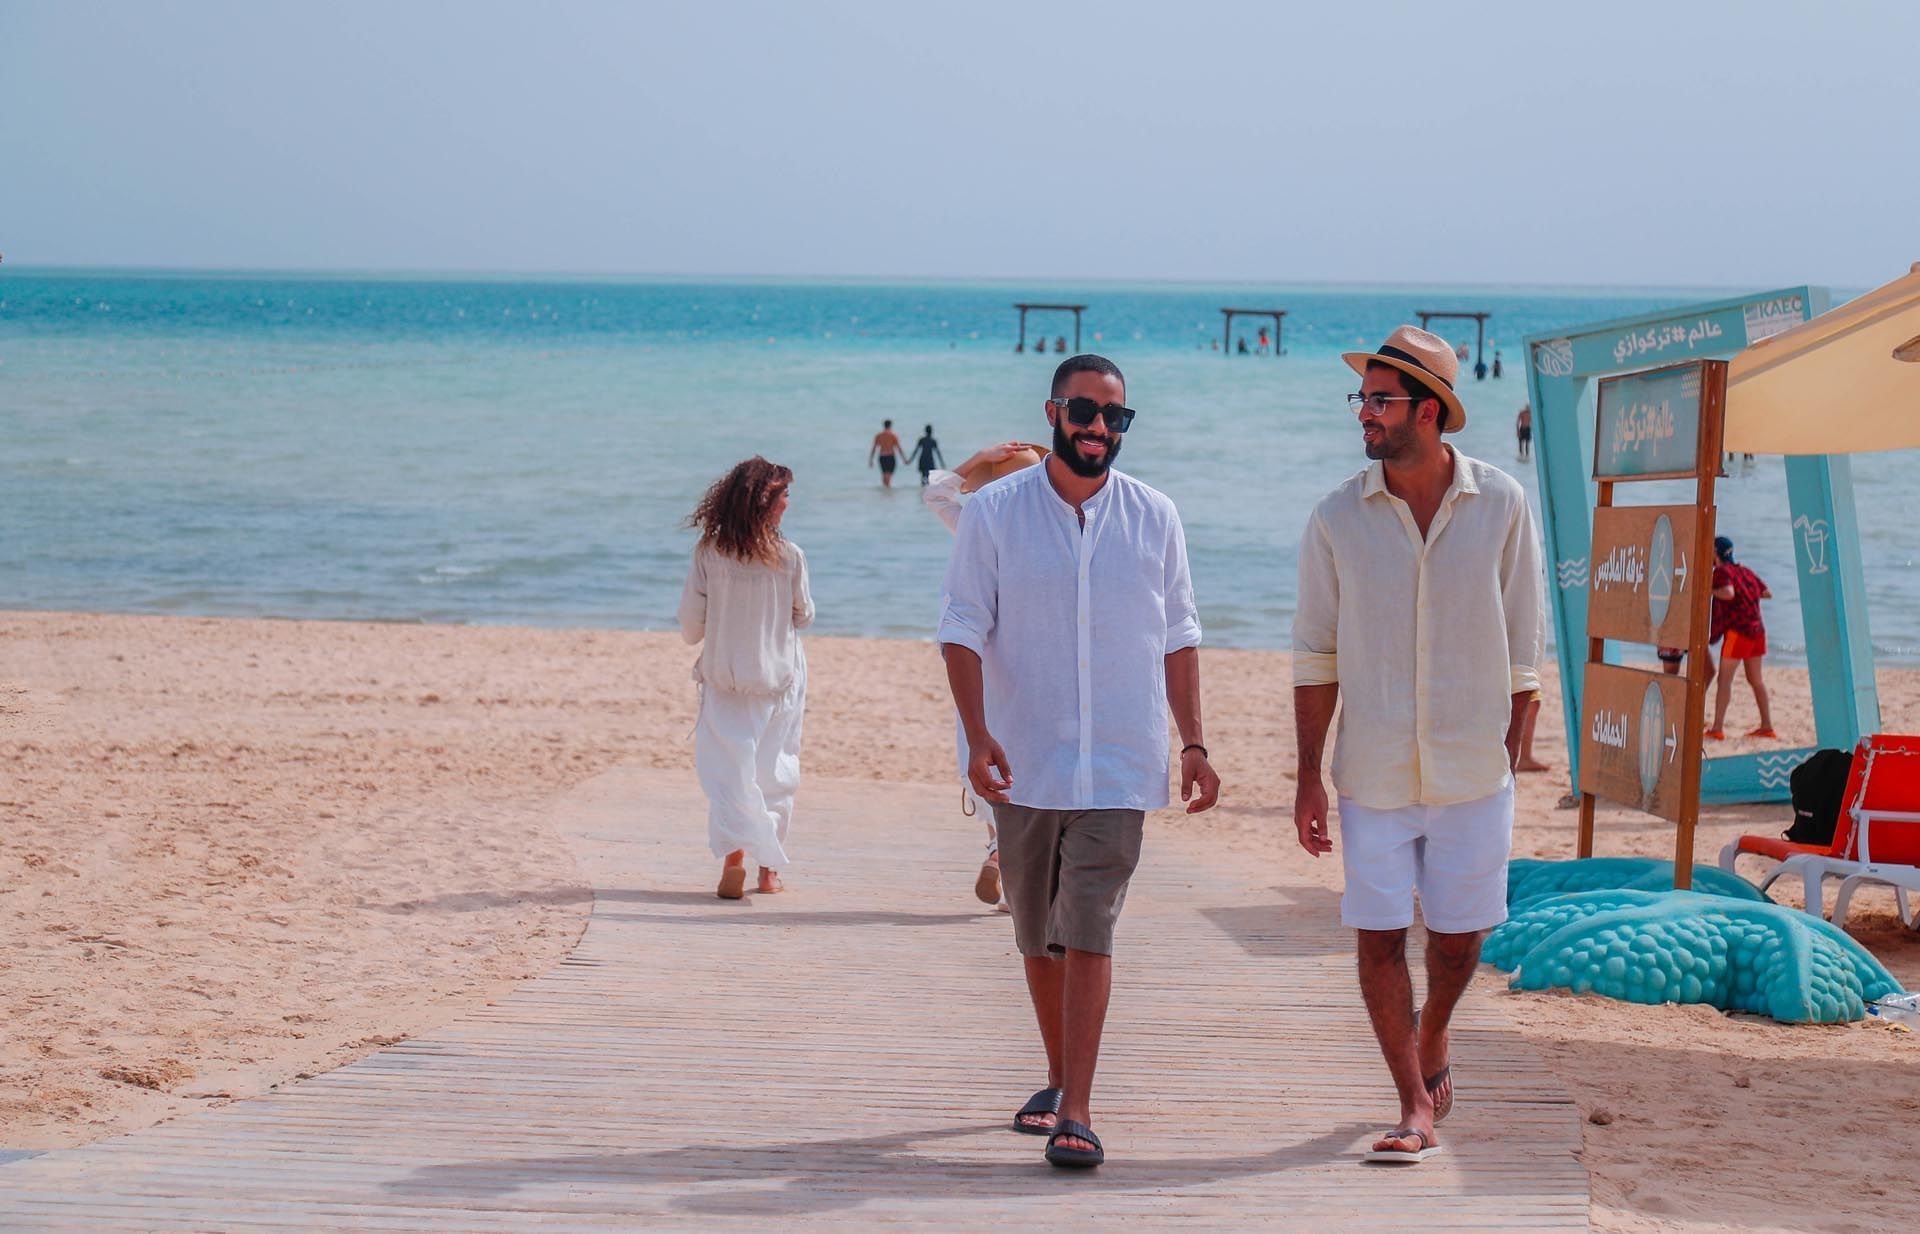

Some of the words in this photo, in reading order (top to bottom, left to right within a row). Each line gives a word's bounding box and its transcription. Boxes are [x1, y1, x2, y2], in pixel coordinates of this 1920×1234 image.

[1594, 545, 1626, 592] الملابس
[1626, 544, 1644, 592] غرفة
[1592, 709, 1627, 750] الحمامات
